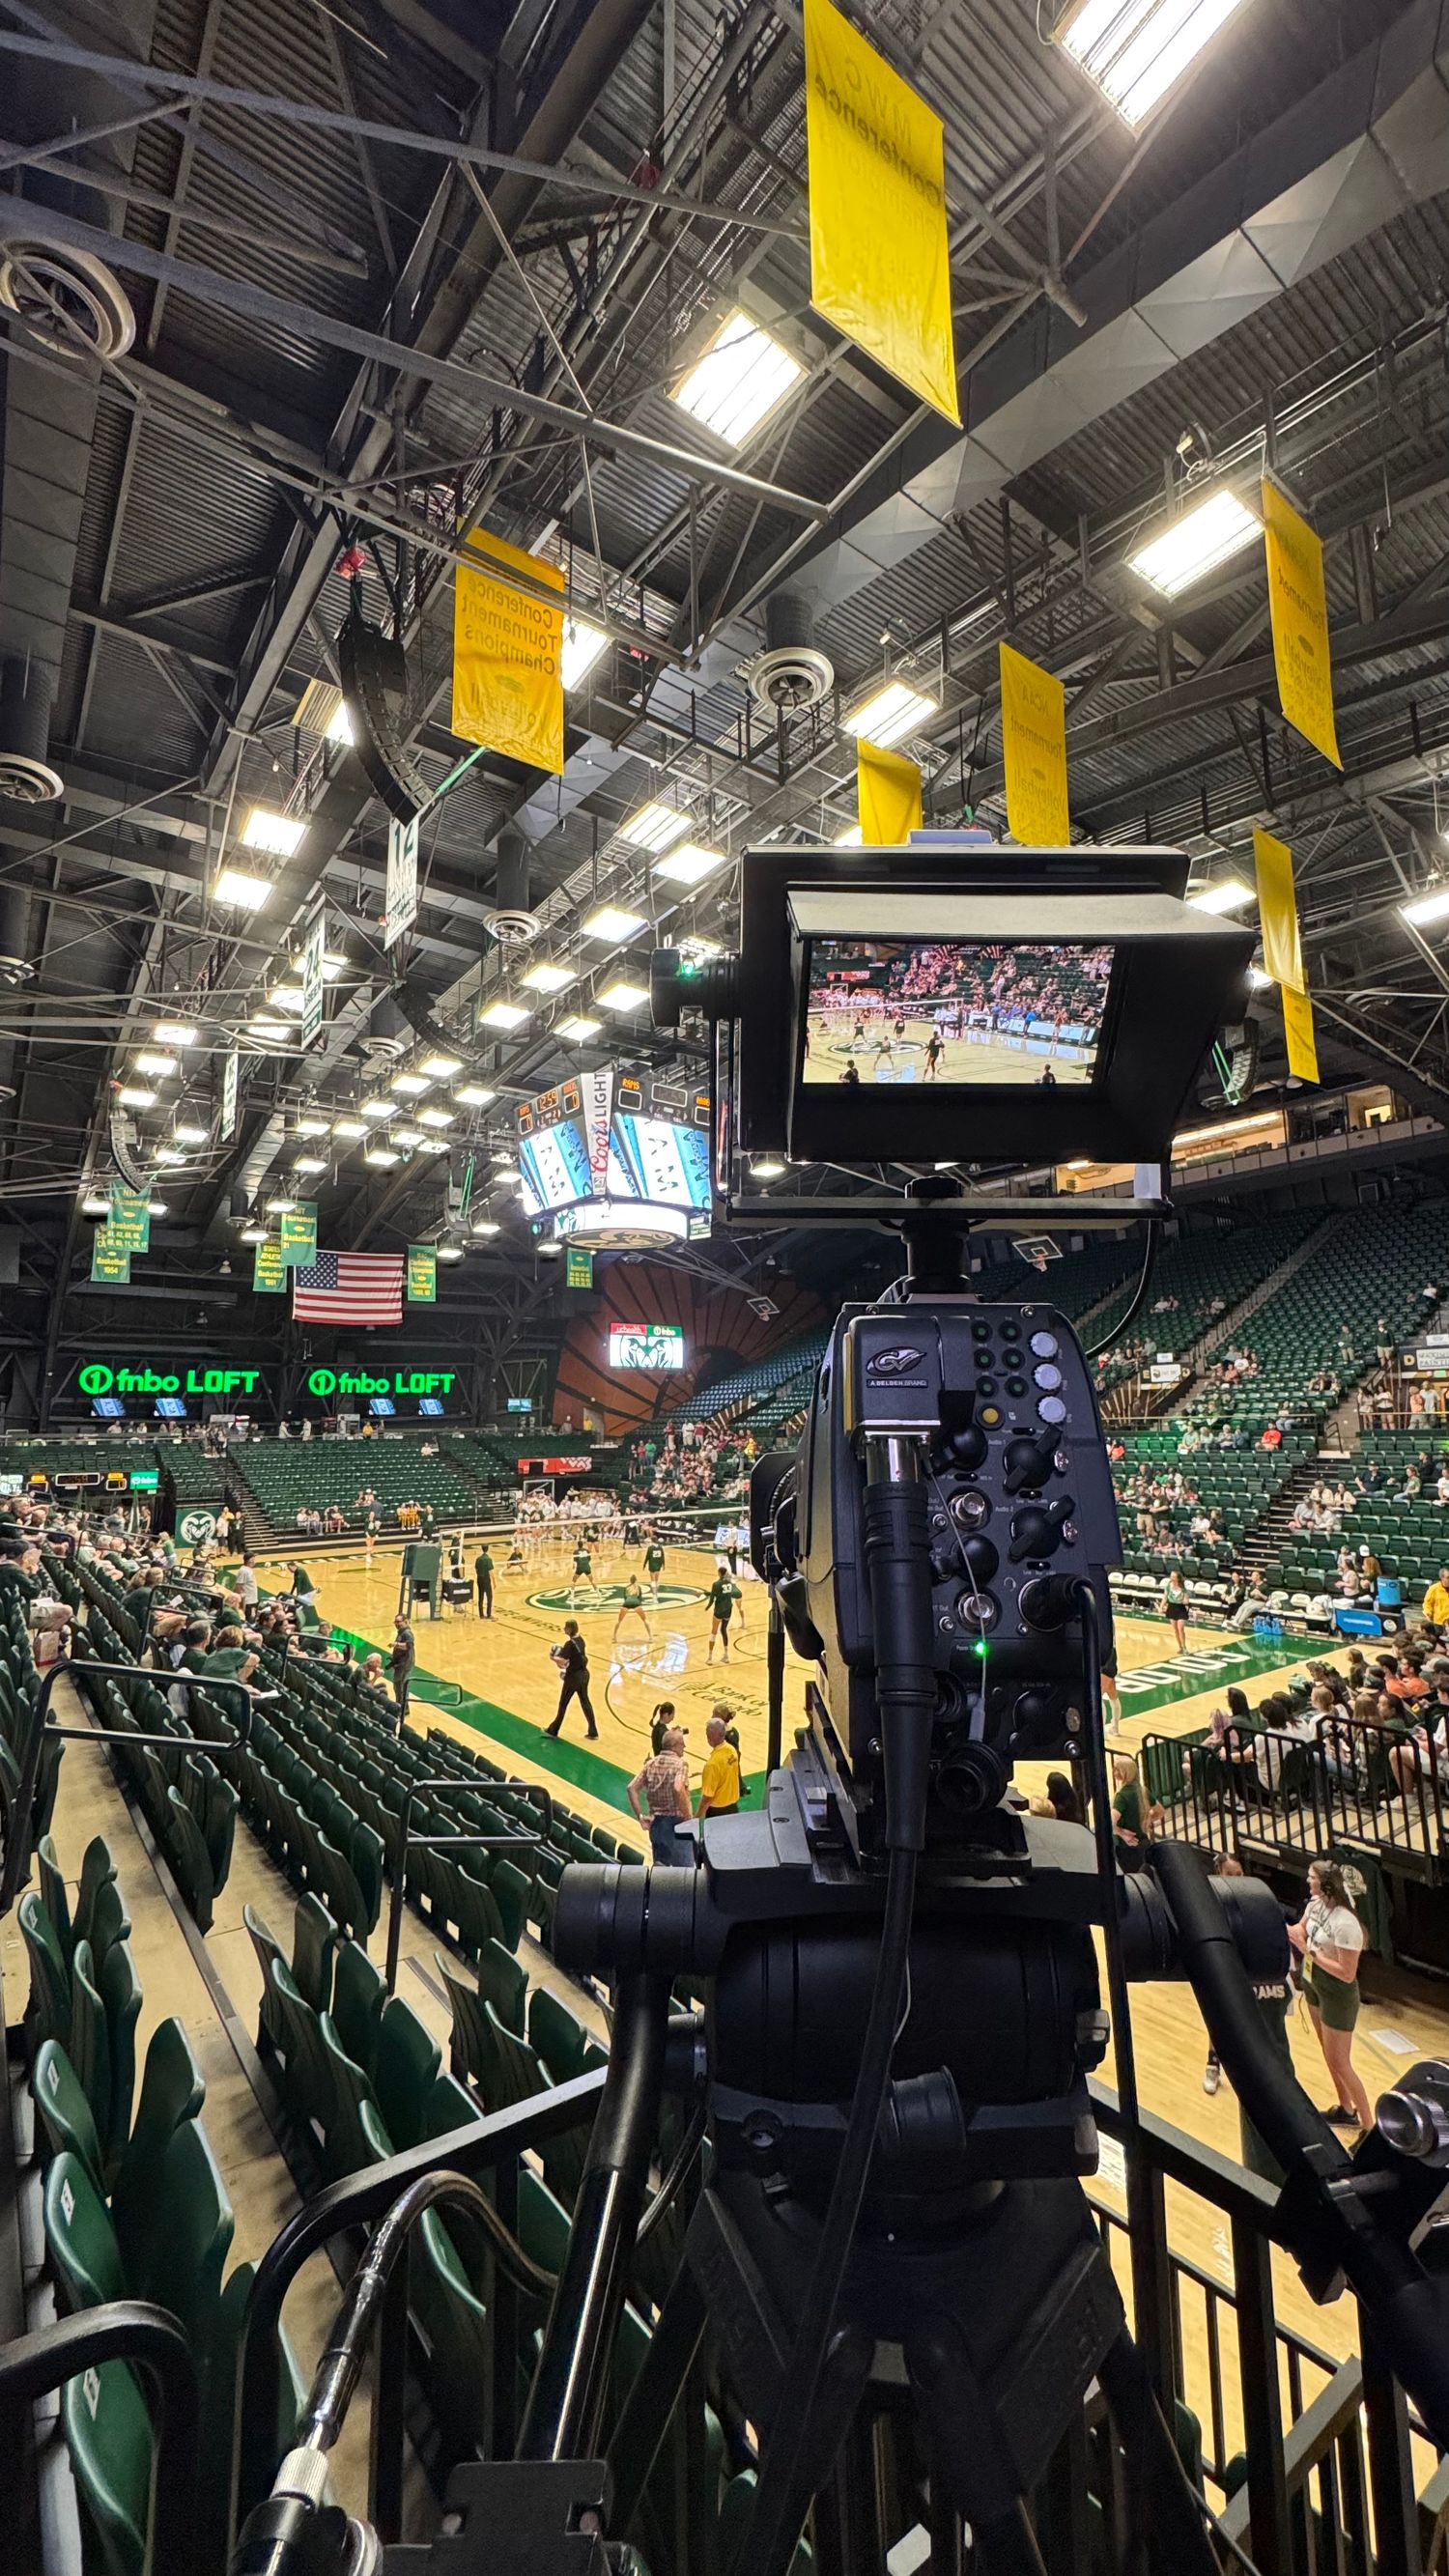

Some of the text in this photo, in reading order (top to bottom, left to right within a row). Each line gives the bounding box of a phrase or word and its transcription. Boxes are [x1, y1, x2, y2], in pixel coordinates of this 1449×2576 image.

[589, 1072, 608, 1175] Coors LIGHT
[116, 1368, 181, 1393] fnbo
[186, 1370, 260, 1393] LOFT
[338, 1372, 390, 1394] fnbo
[395, 1373, 455, 1394] LOFT
[722, 1584, 732, 1594] 33
[711, 1684, 752, 1701] Bank
[1253, 1985, 1286, 1999] AMS
